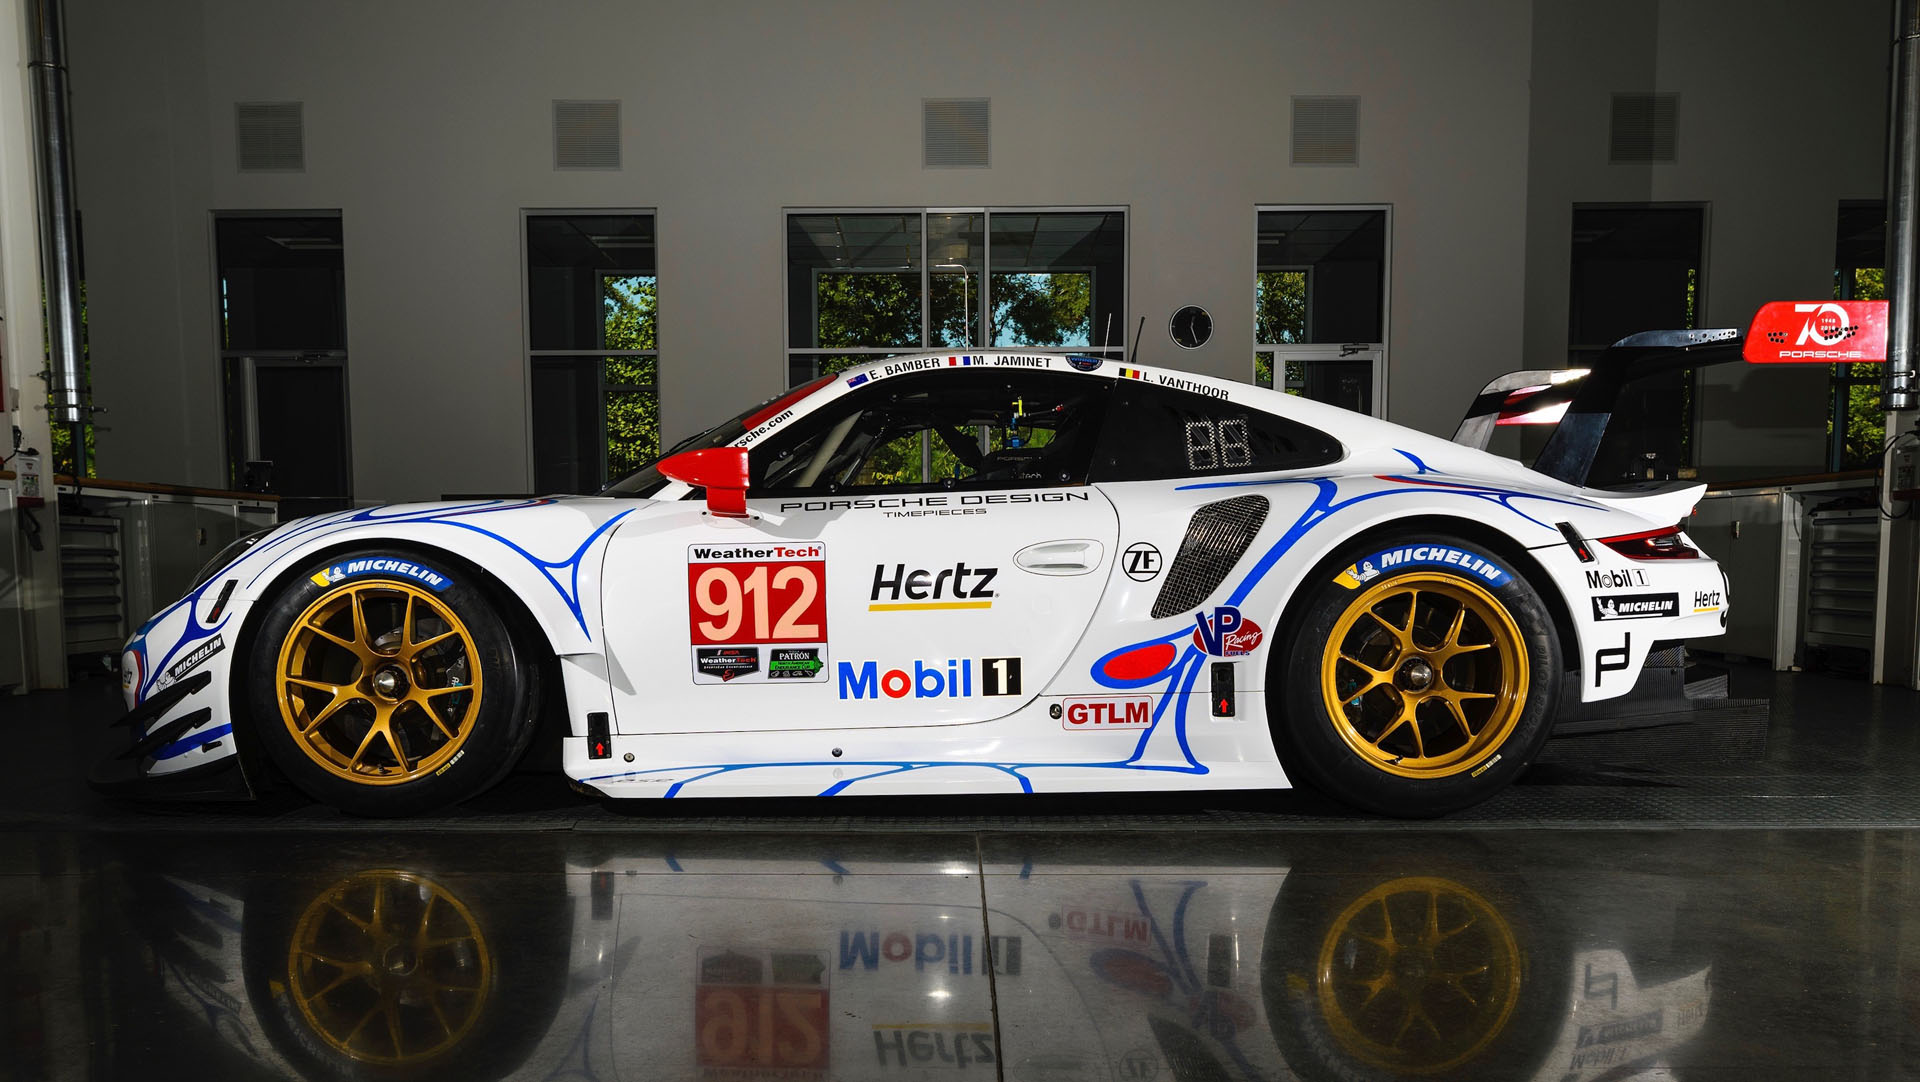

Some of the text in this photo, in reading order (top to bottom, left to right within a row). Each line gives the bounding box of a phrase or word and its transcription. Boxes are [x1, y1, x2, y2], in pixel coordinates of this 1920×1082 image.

[1795, 303, 1850, 346] 70
[972, 355, 1052, 369] M. JAMINET
[1779, 350, 1861, 359] PORSCHE
[868, 357, 941, 381] E. BAMBER
[1143, 371, 1229, 400] L. VANTHOOR
[733, 409, 794, 448] rsche.com
[780, 491, 1089, 512] PORSCHE DESIGN
[883, 508, 987, 518] TIMEPIECES
[694, 547, 820, 559] WeatherTech
[1125, 550, 1159, 574] ZF
[1381, 547, 1502, 581] MICHELIN
[348, 560, 443, 586] MICHELIN
[870, 562, 999, 600] Hertz
[1585, 569, 1633, 589] Mobil
[695, 565, 819, 641] 912
[1619, 600, 1674, 613] MICHELIN
[1693, 590, 1721, 608] Hertz
[1195, 607, 1241, 656] VP
[1225, 630, 1263, 650] Racing
[174, 637, 222, 677] MICHELIN
[838, 659, 972, 700] Mobil
[1067, 702, 1149, 724] GTLM
